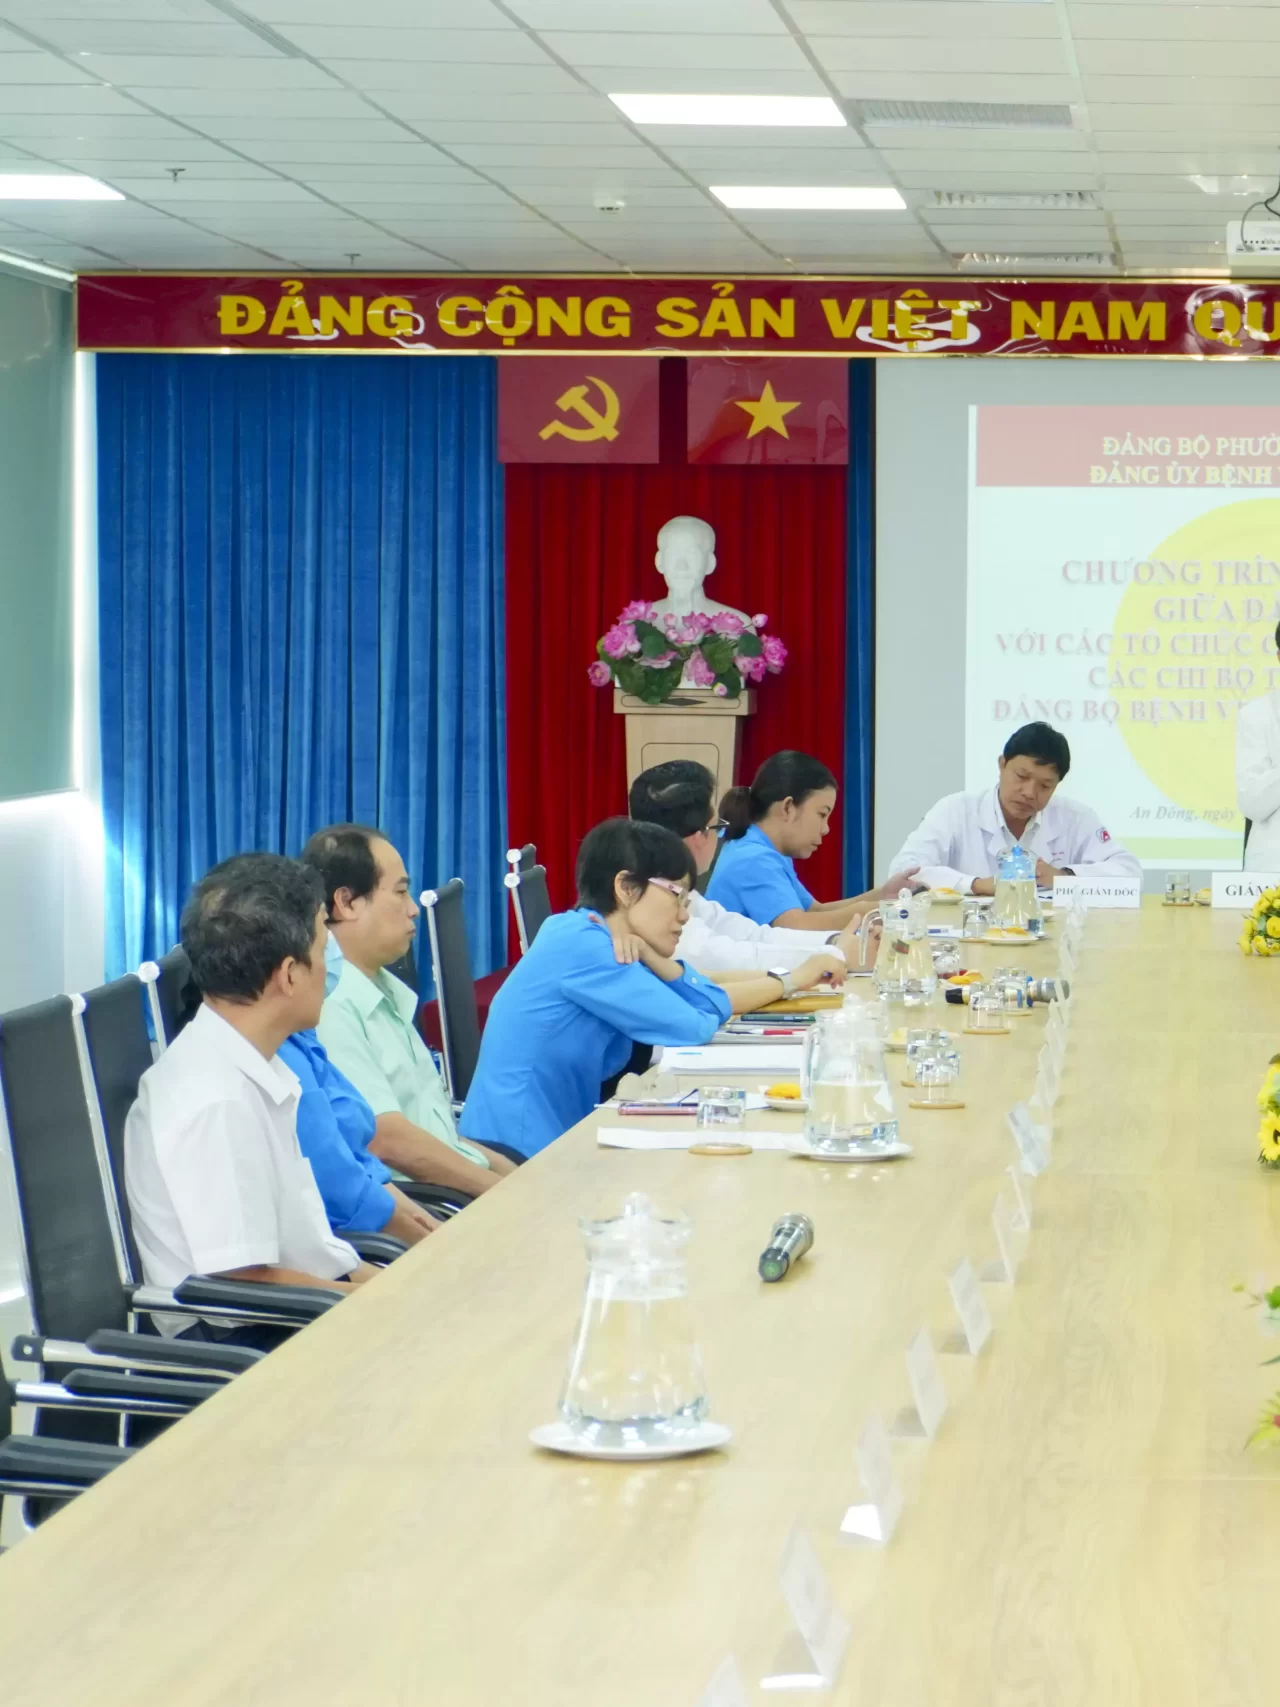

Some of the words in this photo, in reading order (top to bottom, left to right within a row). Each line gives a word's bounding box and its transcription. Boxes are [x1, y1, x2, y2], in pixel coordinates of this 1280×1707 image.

[217, 280, 414, 338] ĐẢNG
[437, 285, 631, 346] CỘNG
[654, 282, 796, 339] SẢN
[820, 288, 981, 352] VIỆT
[1010, 300, 1167, 342] NAM
[1102, 432, 1171, 457] ĐẢNG
[1177, 434, 1210, 459] BỘ
[1089, 460, 1160, 485] ĐẢNG
[1205, 463, 1273, 488] BỆNH
[1061, 557, 1202, 586] CHƯƠNG
[1153, 592, 1237, 623] GIỮA
[995, 628, 1048, 657] VỚI
[1055, 627, 1114, 657] CÁC
[1087, 660, 1148, 690] CÁC
[1156, 666, 1210, 691] CHI
[1216, 664, 1255, 694] BỘ
[1082, 697, 1121, 727] BỘ
[1130, 697, 1208, 728] BỆNH
[1128, 805, 1151, 820] An
[1081, 885, 1112, 897] GIÁM
